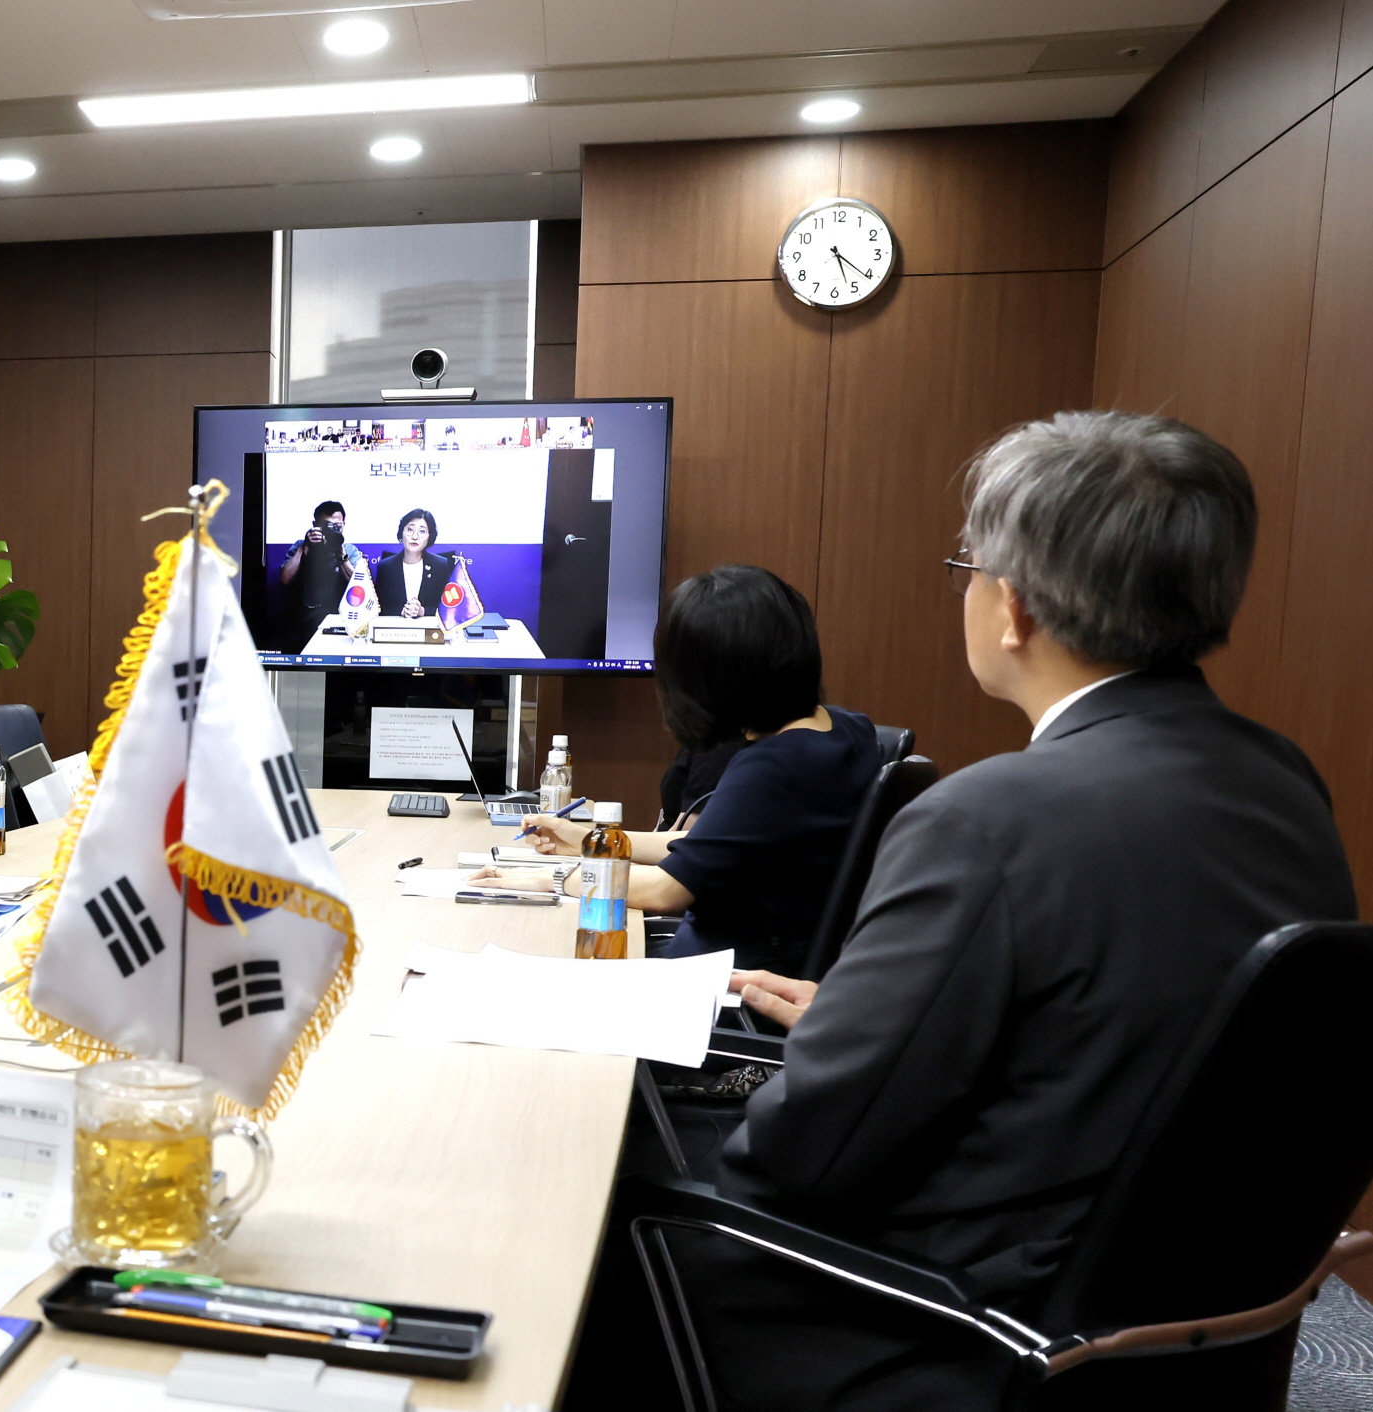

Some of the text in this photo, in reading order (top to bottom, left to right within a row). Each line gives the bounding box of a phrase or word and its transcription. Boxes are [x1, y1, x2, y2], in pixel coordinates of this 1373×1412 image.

[833, 211, 846, 222] 12
[857, 216, 862, 228] 1
[814, 218, 824, 229] 11
[799, 233, 812, 244] 10
[869, 230, 878, 241] 2
[792, 251, 802, 263] 9
[874, 249, 882, 261] 3
[798, 270, 806, 281] 8
[864, 268, 873, 280] 4
[812, 282, 820, 294] 7
[830, 287, 839, 298] 6
[850, 281, 859, 293] 5
[369, 462, 442, 477] 보건복지부
